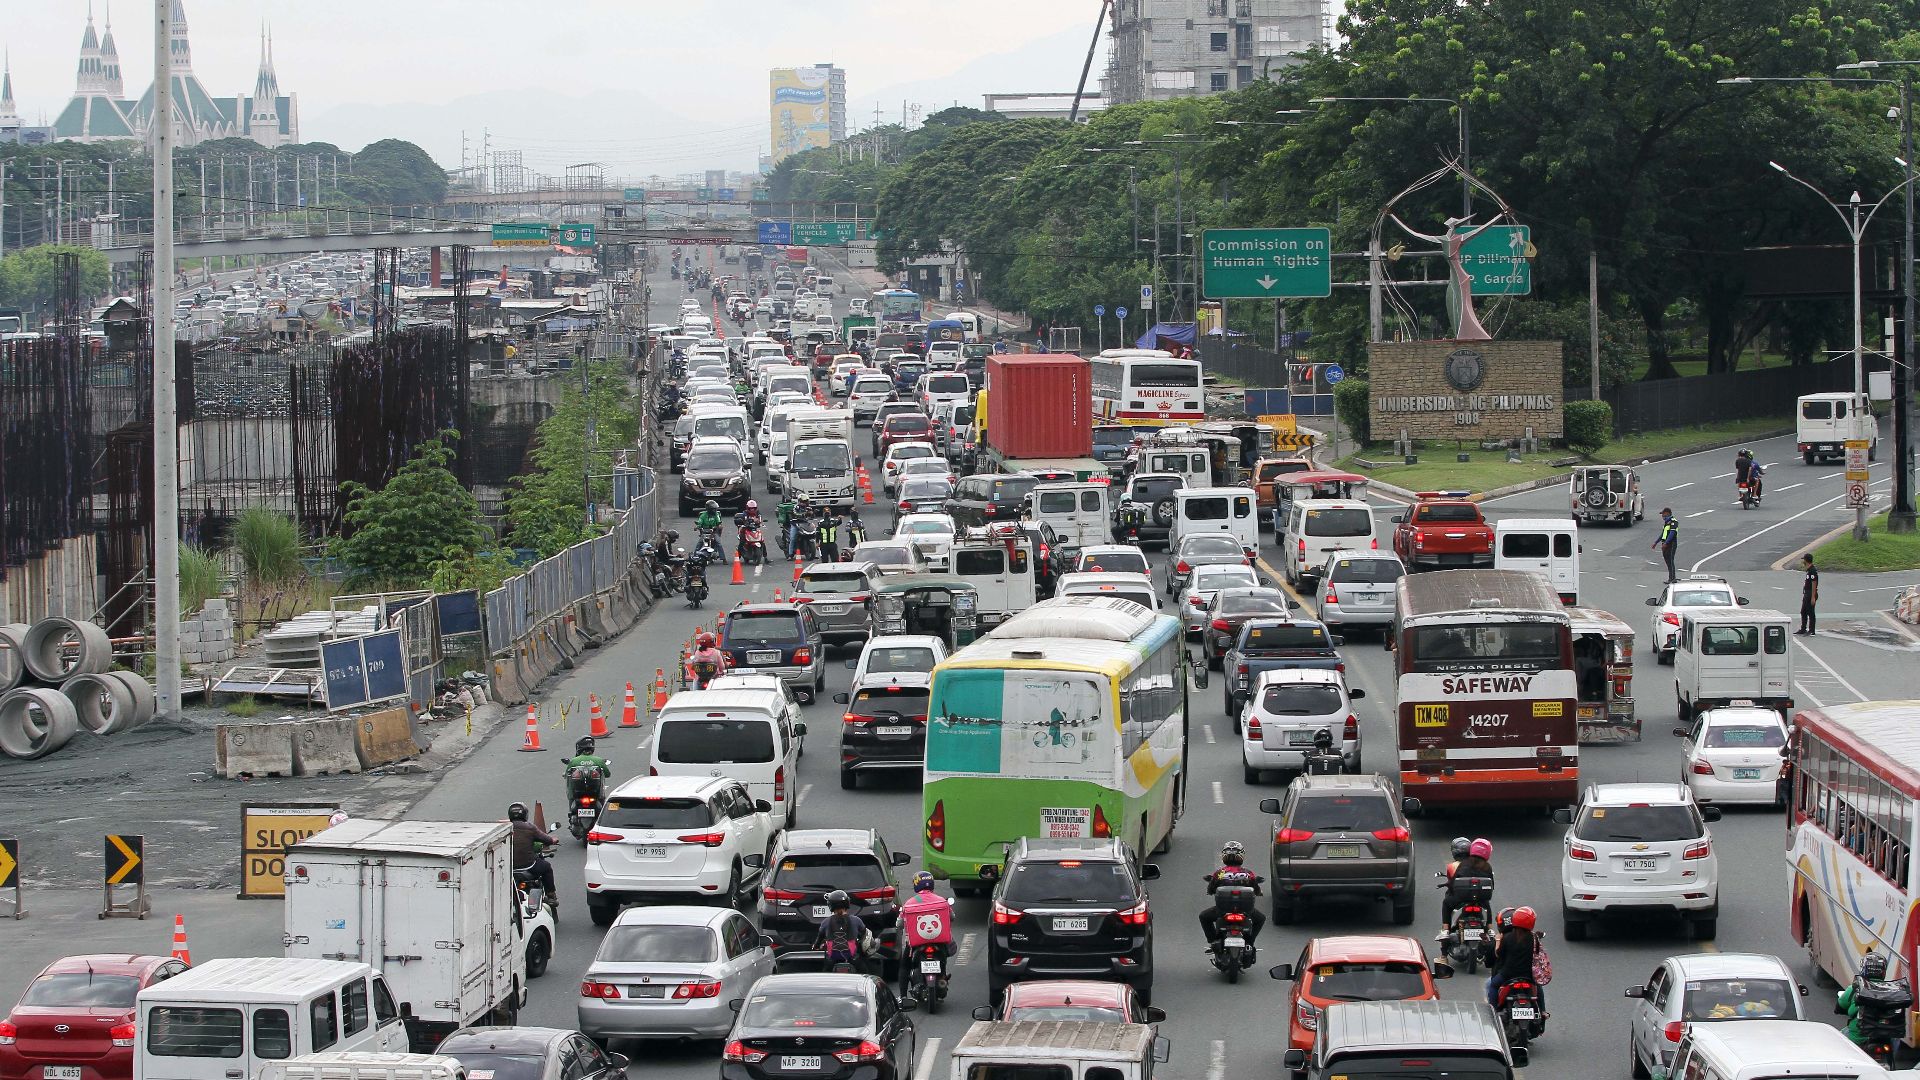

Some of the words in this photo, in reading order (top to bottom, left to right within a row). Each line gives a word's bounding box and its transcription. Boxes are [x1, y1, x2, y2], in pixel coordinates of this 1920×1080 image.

[1208, 239, 1298, 251] Commission
[1306, 241, 1324, 250] on
[1213, 256, 1265, 267] Human
[1273, 255, 1319, 268] Rights
[1484, 273, 1524, 285] Garcia
[1137, 389, 1174, 398] MAGICLINE
[1469, 395, 1487, 411] NG
[1491, 395, 1554, 411] PILIPINAS
[1453, 412, 1480, 425] 1908
[1442, 676, 1533, 694] SAFEWAY
[1416, 707, 1432, 724] TXM
[1433, 707, 1447, 723] 408
[1468, 714, 1509, 727] 14207
[651, 848, 666, 856] 9958
[1624, 860, 1636, 868] NCT
[1639, 860, 1655, 868] 7501
[813, 907, 826, 915] NEB
[1053, 920, 1066, 928] NDT
[1070, 920, 1087, 928] 6285
[782, 1058, 796, 1067] NAP
[801, 1058, 820, 1067] 3280
[44, 1068, 58, 1077] NDL
[62, 1069, 80, 1078] 6853
